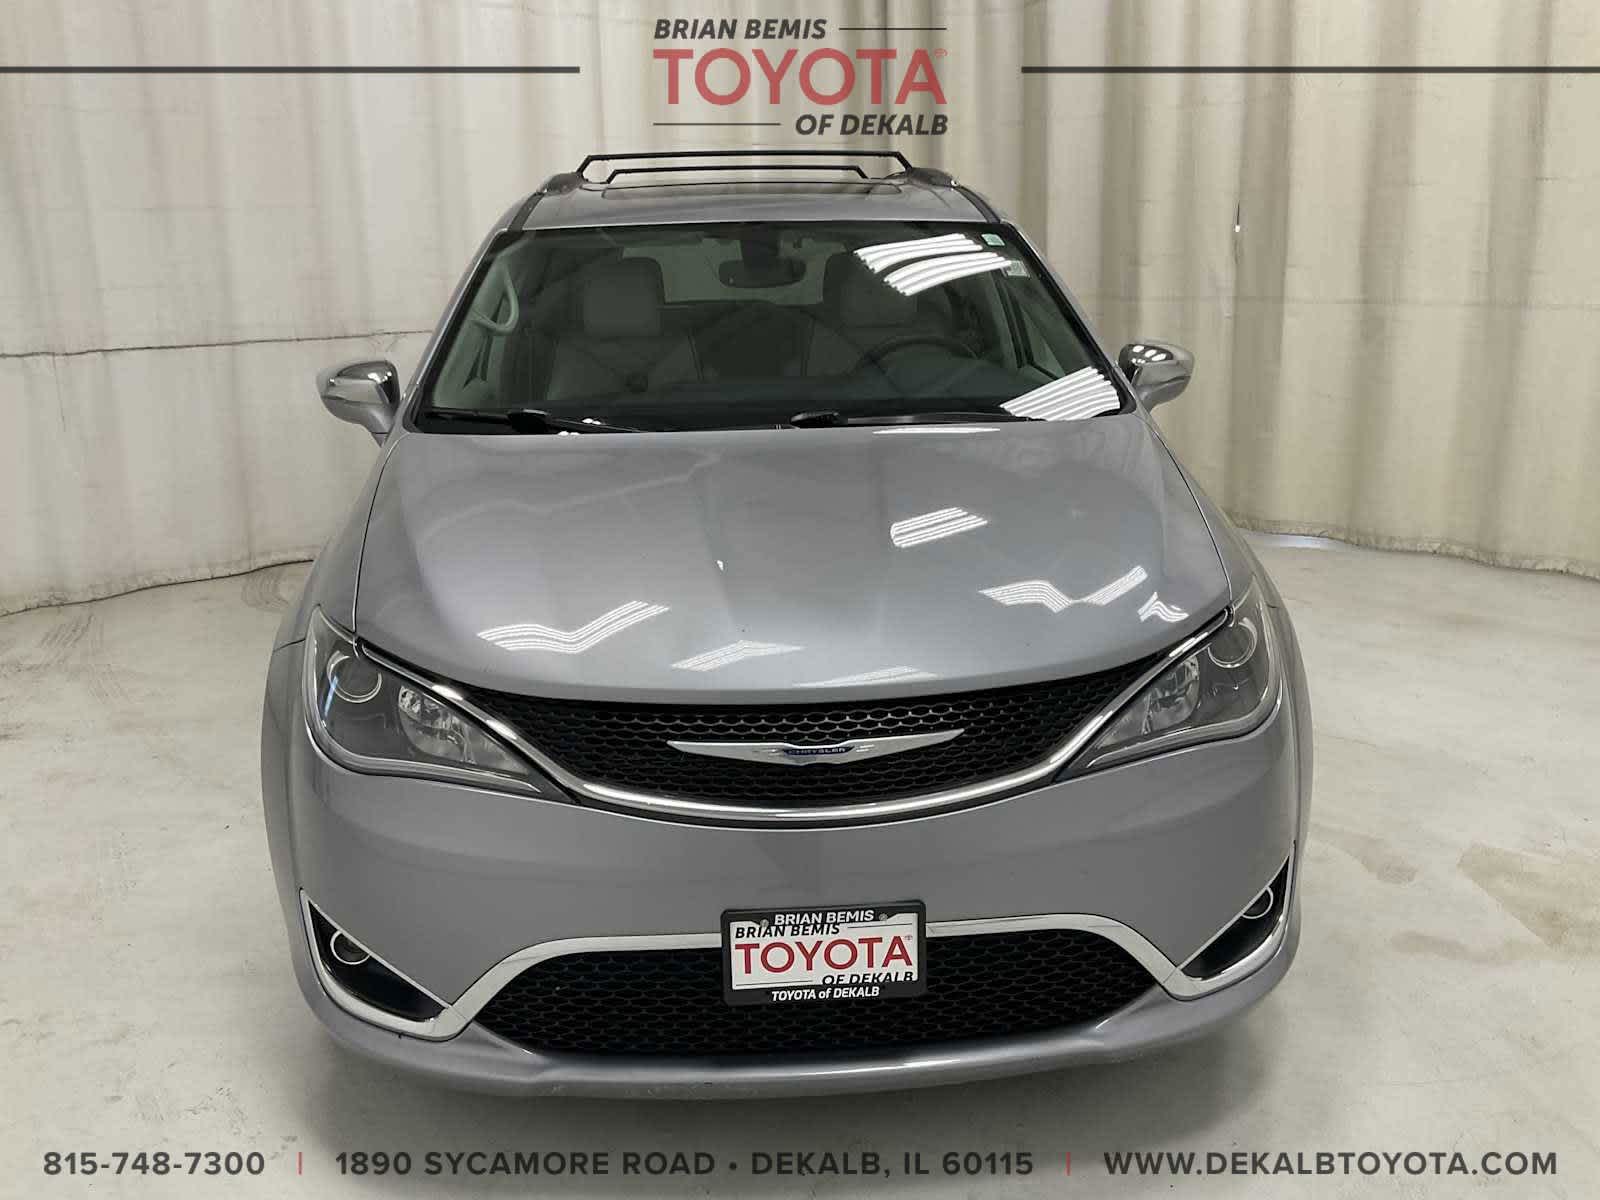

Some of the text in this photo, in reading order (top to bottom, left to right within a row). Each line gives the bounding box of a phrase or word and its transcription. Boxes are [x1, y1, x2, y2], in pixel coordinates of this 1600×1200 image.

[774, 910, 875, 926] BRIAN BEMIS
[735, 923, 840, 938] BRIAN BEMIS
[735, 936, 912, 974] TOYOTA
[849, 971, 914, 985] DEKALB
[772, 986, 880, 1001] TOYOTA of DEKALB
